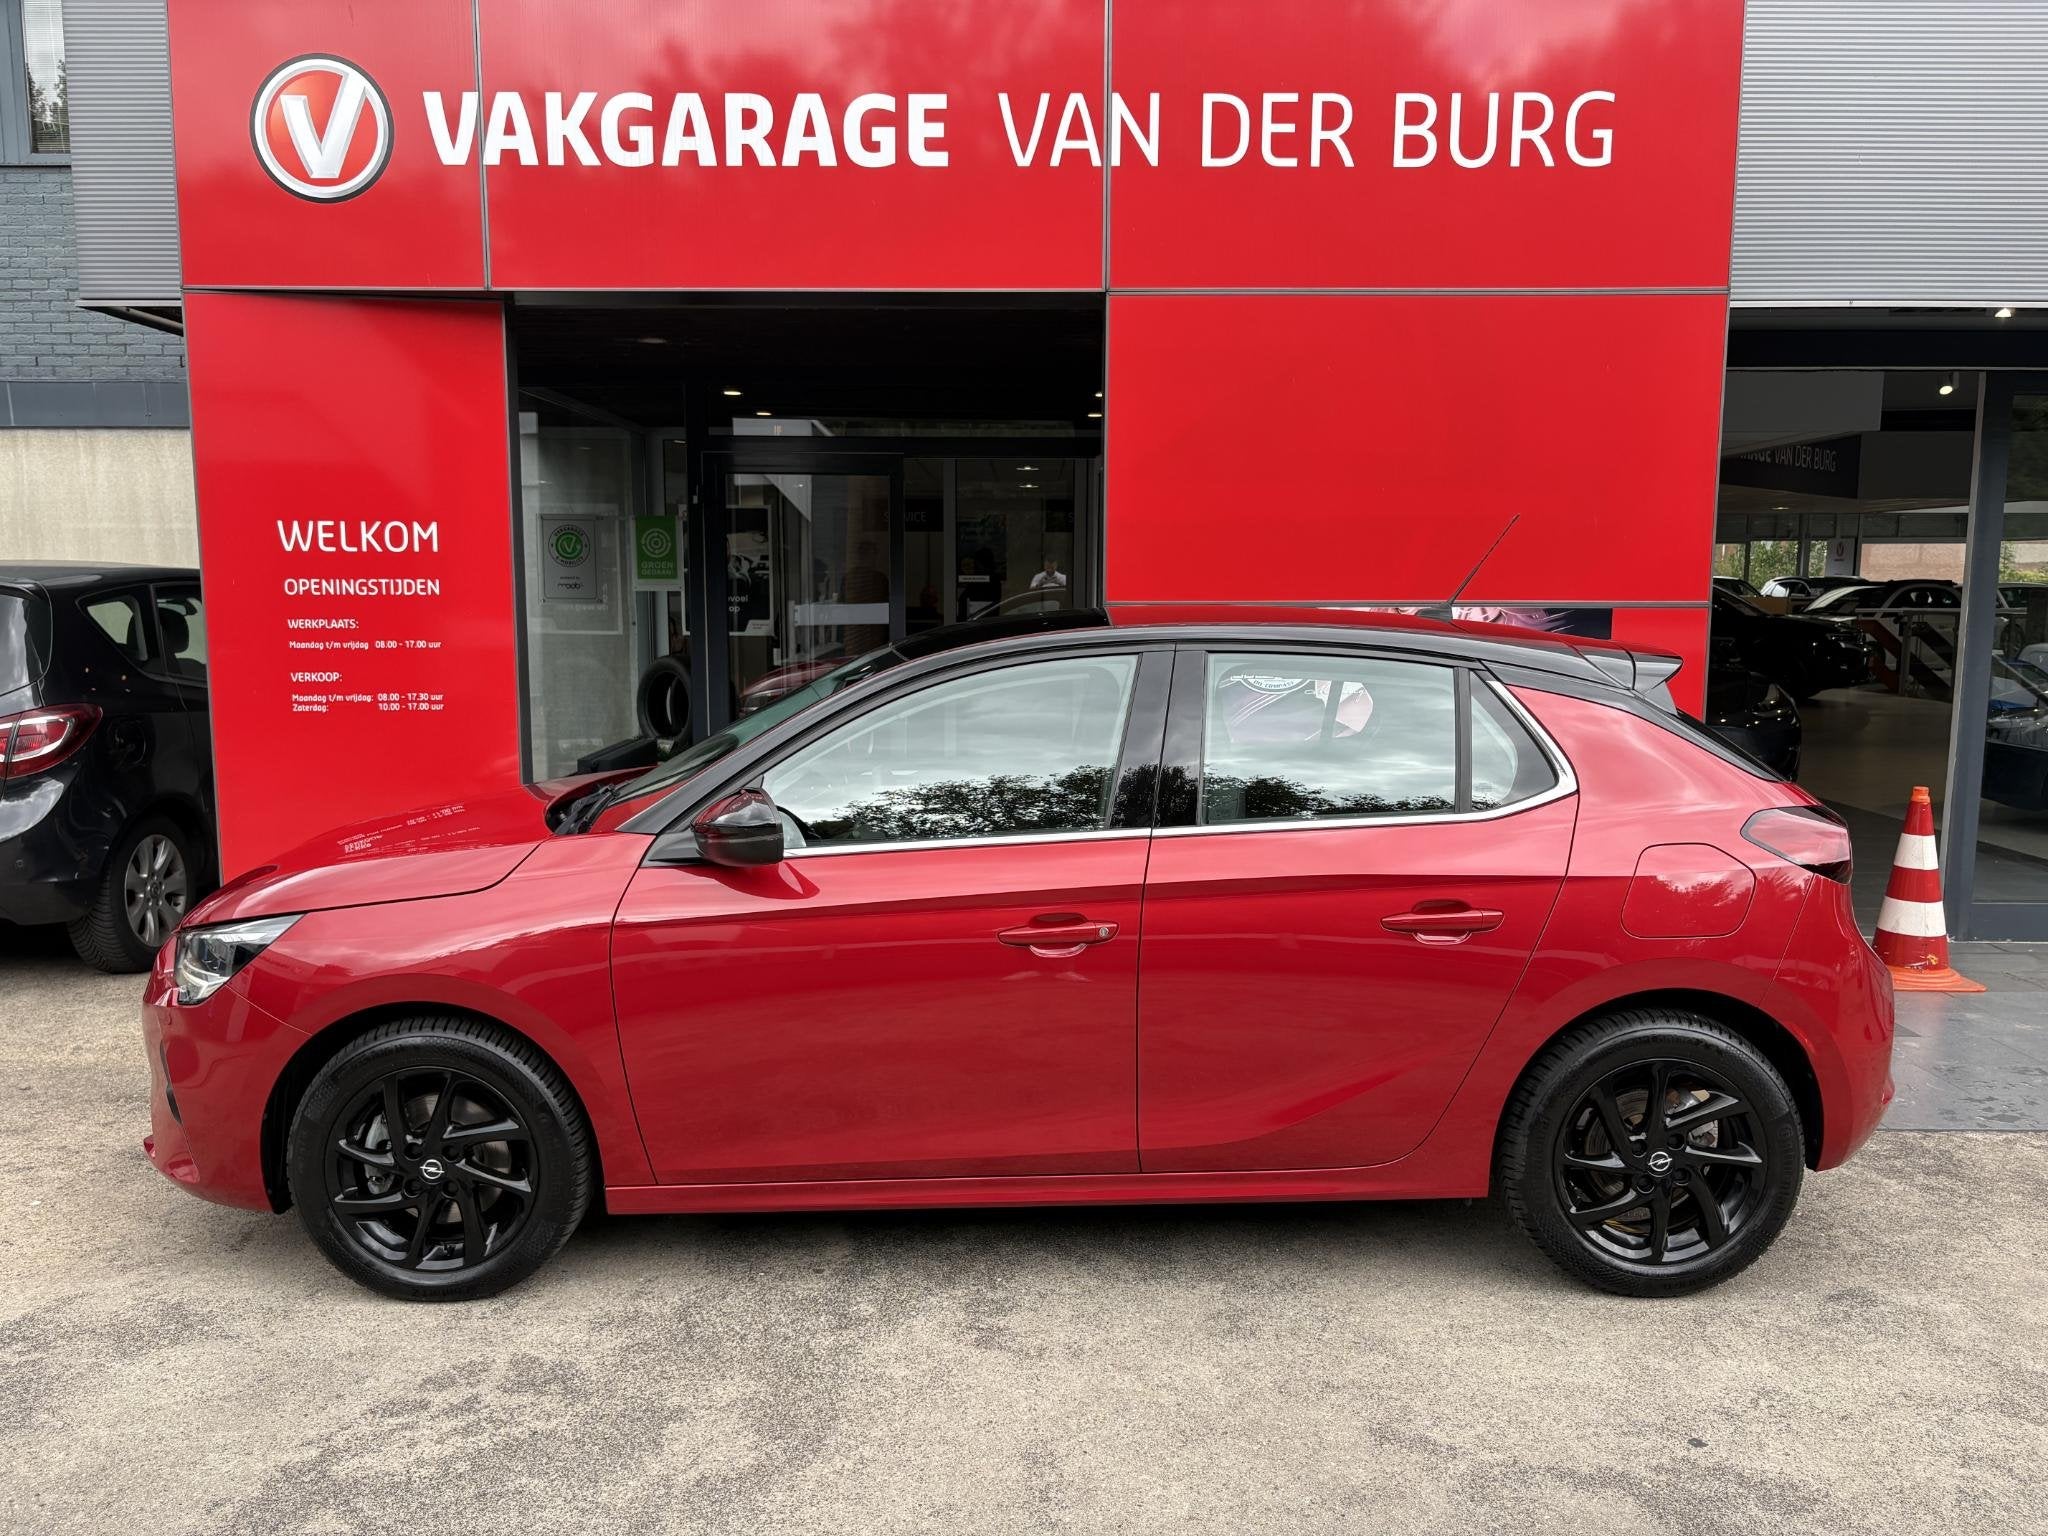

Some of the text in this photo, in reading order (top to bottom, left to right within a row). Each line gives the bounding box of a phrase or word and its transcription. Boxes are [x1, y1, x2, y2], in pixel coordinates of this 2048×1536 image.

[422, 91, 1616, 169] VAKGARAGE VAN DER BURG
[1774, 446, 1794, 465] VAN
[1795, 446, 1814, 469] DER
[1813, 447, 1837, 472] BURG
[276, 519, 439, 553] WELKOM
[283, 578, 440, 596] OPENINGSTIJDEN
[287, 618, 359, 629] WERKPLAATS:
[289, 640, 324, 651] Maandag
[325, 640, 341, 650] t/m
[342, 640, 369, 650] vrijdag
[375, 639, 398, 649] 08.00
[405, 639, 427, 649] 17.00
[428, 641, 442, 649] uur
[290, 671, 343, 683] VERKOOP:
[291, 693, 327, 704] Maandag
[328, 693, 344, 703] t/m
[345, 693, 374, 703] vrijdag:
[377, 692, 400, 702] 08.00
[407, 692, 429, 701] 17.30
[292, 703, 329, 713] Zaterdag:
[378, 702, 400, 711] 10.00
[407, 702, 430, 711] 17.00
[431, 703, 445, 711] uur
